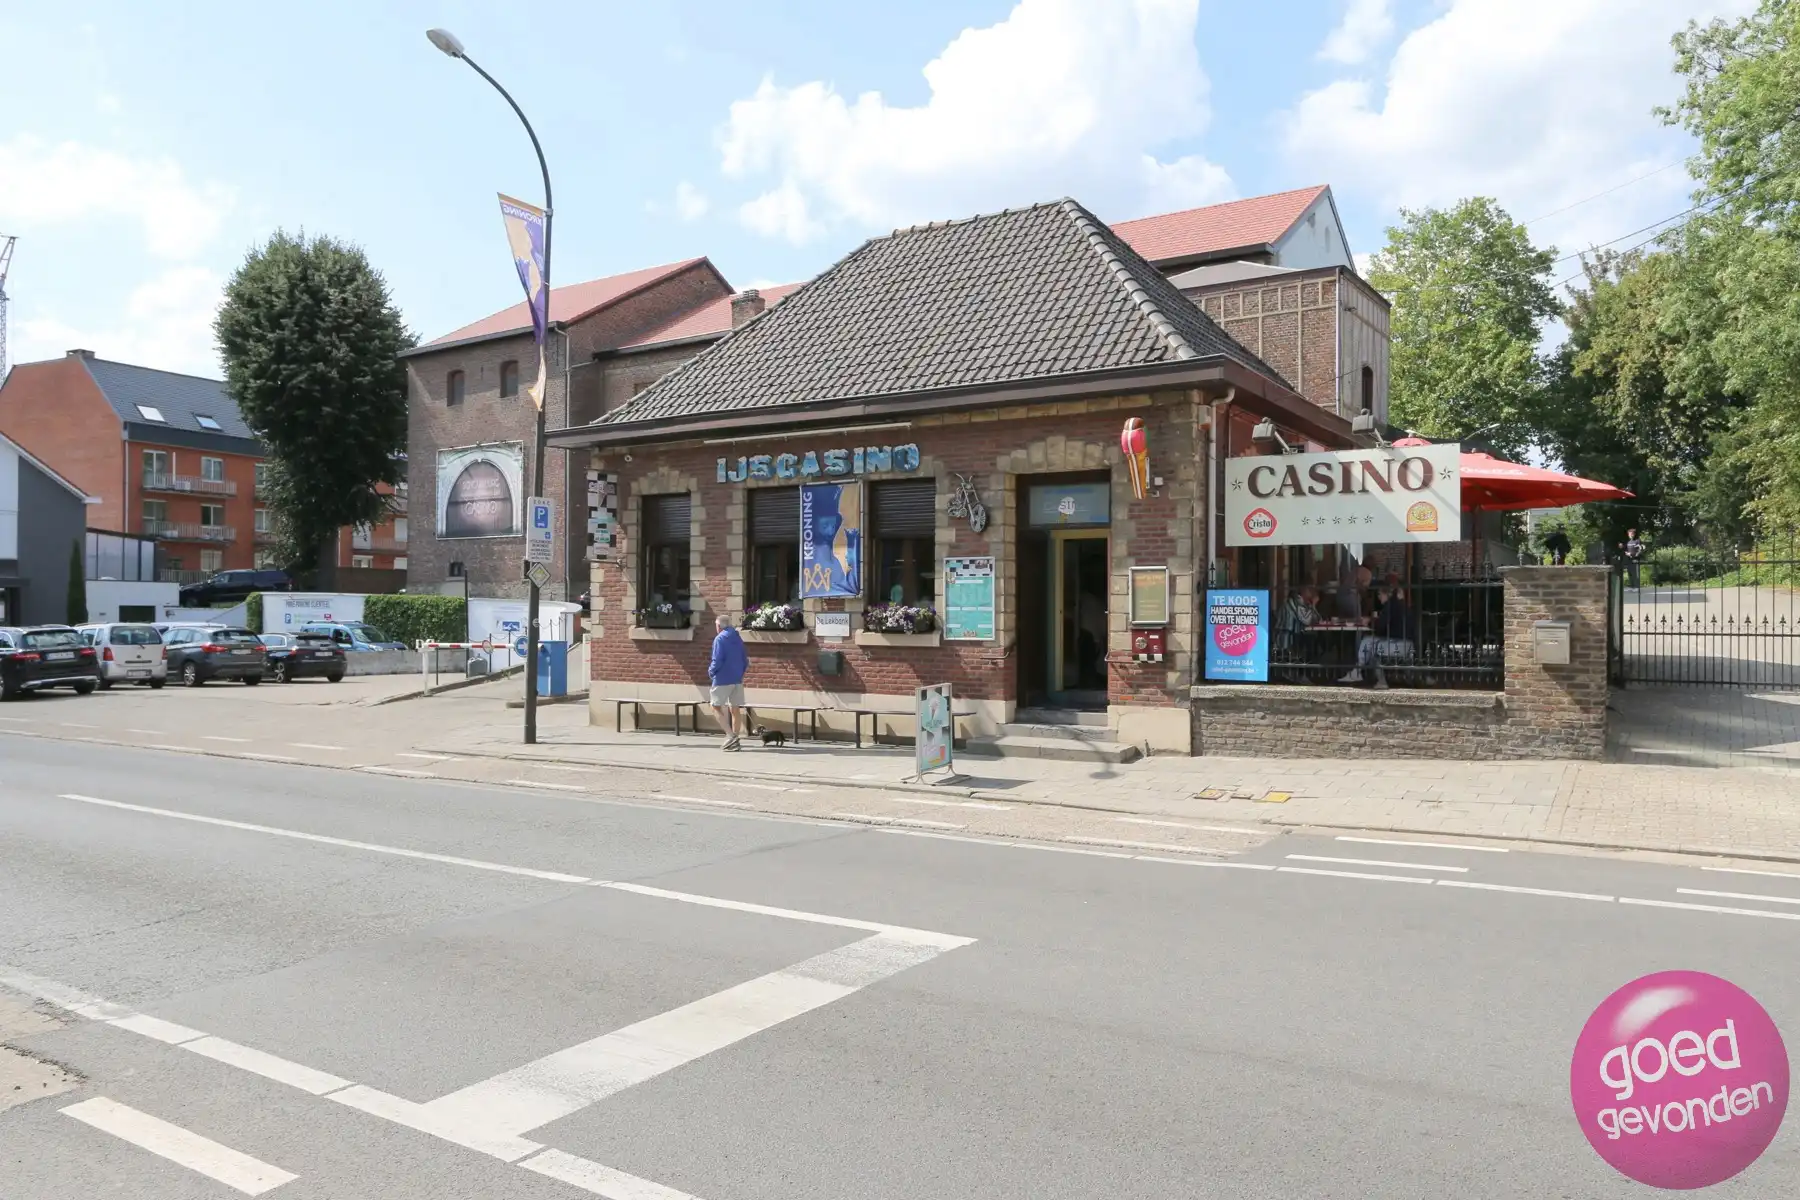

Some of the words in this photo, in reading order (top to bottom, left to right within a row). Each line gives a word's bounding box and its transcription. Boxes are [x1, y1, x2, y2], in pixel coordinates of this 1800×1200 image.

[716, 443, 920, 483] IJSCASINO
[1247, 456, 1434, 498] CASINO
[803, 491, 814, 560] KRONING
[1247, 518, 1273, 530] Cristal
[1212, 595, 1225, 606] TE
[1228, 595, 1258, 606] KOOP
[1210, 606, 1259, 615] HANDELSFONDS
[1210, 615, 1227, 624] OVER
[1227, 615, 1235, 624] TE
[1235, 616, 1258, 625] NEMEN
[1220, 631, 1255, 648] gevonden
